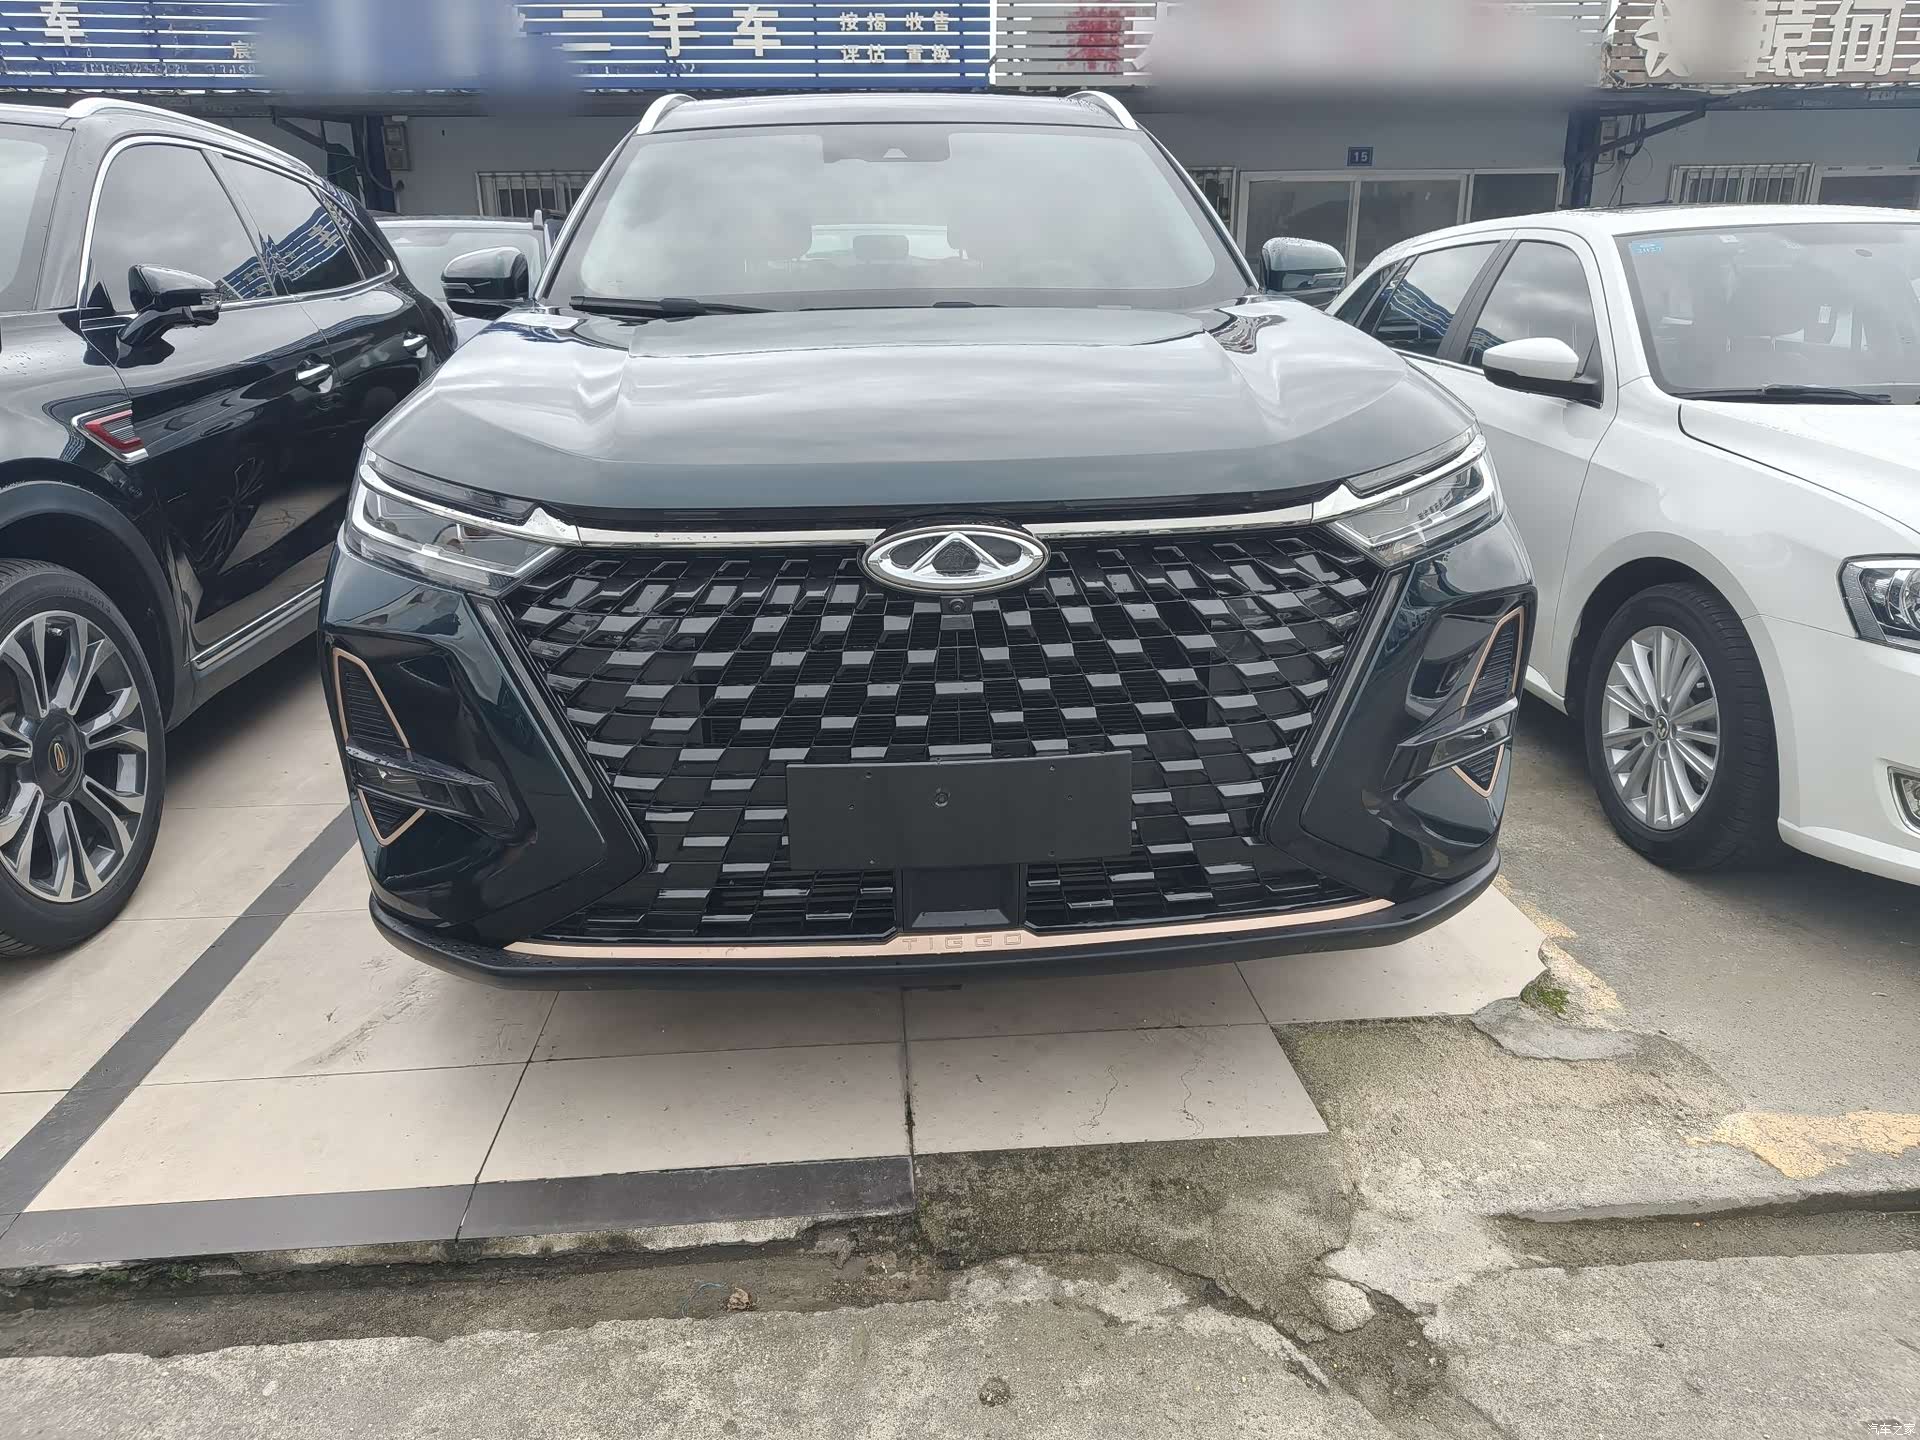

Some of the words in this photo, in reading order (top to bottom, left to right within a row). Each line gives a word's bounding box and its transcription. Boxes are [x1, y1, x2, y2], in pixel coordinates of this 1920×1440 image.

[40, 0, 85, 46] 车
[562, 4, 782, 57] 二手车
[840, 11, 886, 31] 按揭
[1353, 151, 1369, 162] 15
[901, 932, 1022, 951] TIGGO
